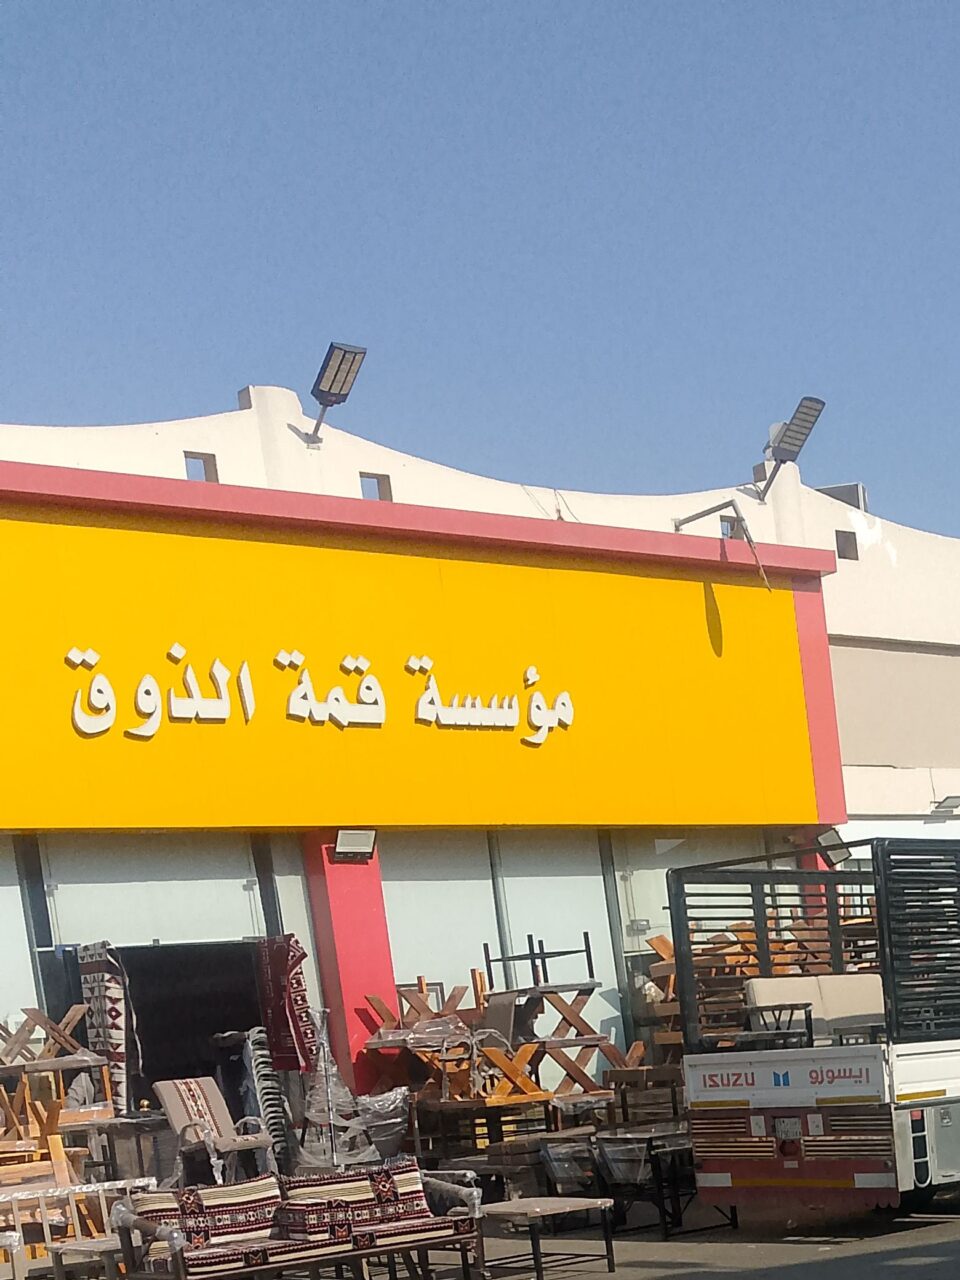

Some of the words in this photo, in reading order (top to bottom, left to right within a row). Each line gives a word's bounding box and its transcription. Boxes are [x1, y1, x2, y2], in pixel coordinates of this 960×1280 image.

[64, 642, 255, 741] الذوق
[273, 648, 387, 728] قمة
[404, 654, 575, 746] مؤسسة
[703, 1072, 755, 1089] ISUZU
[808, 1066, 870, 1085] ايسوزو
